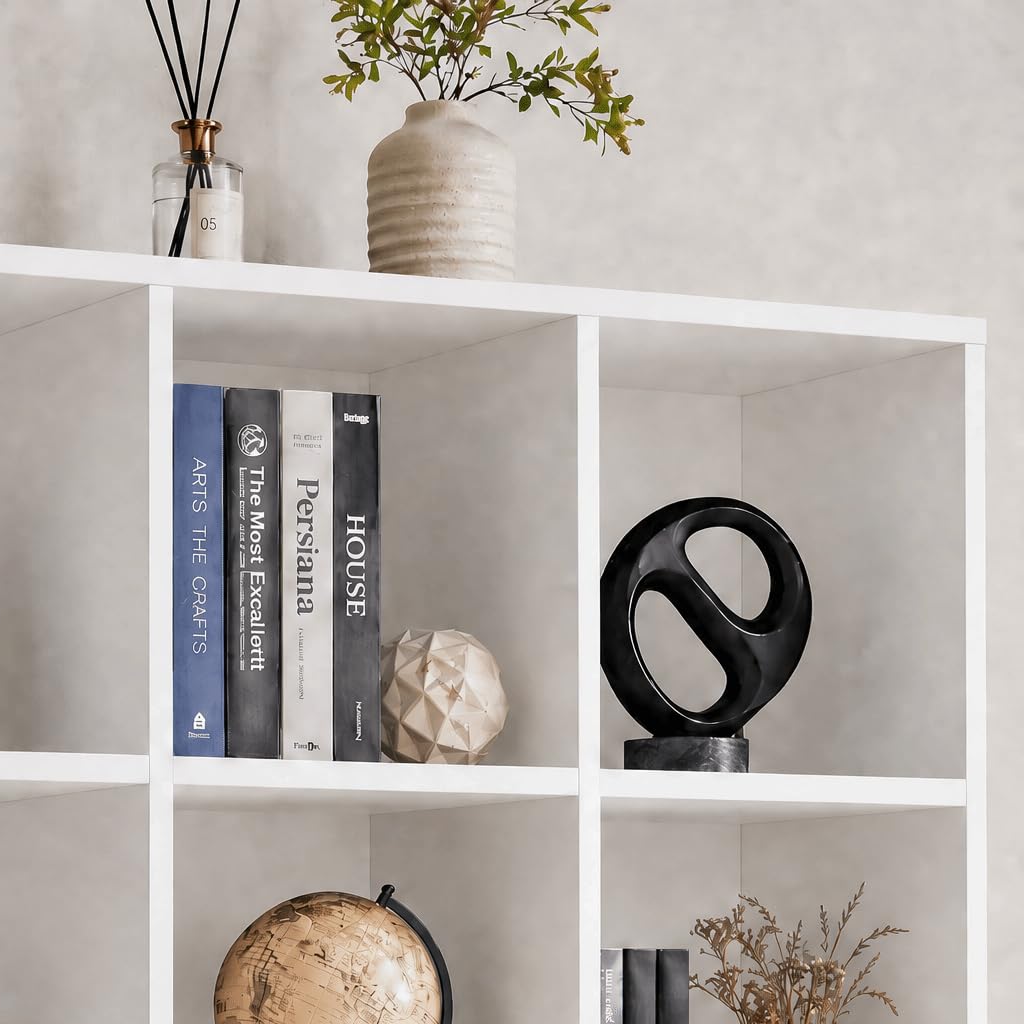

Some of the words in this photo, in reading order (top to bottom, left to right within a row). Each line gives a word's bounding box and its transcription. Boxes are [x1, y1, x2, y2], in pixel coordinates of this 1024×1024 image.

[200, 217, 217, 231] 05
[192, 457, 207, 514] ARTS
[250, 466, 265, 506] The
[192, 527, 207, 565] THE
[250, 511, 265, 564] Most
[296, 477, 320, 616] Persiana
[346, 514, 366, 618] HOUSE
[192, 576, 207, 655] CRAFTS
